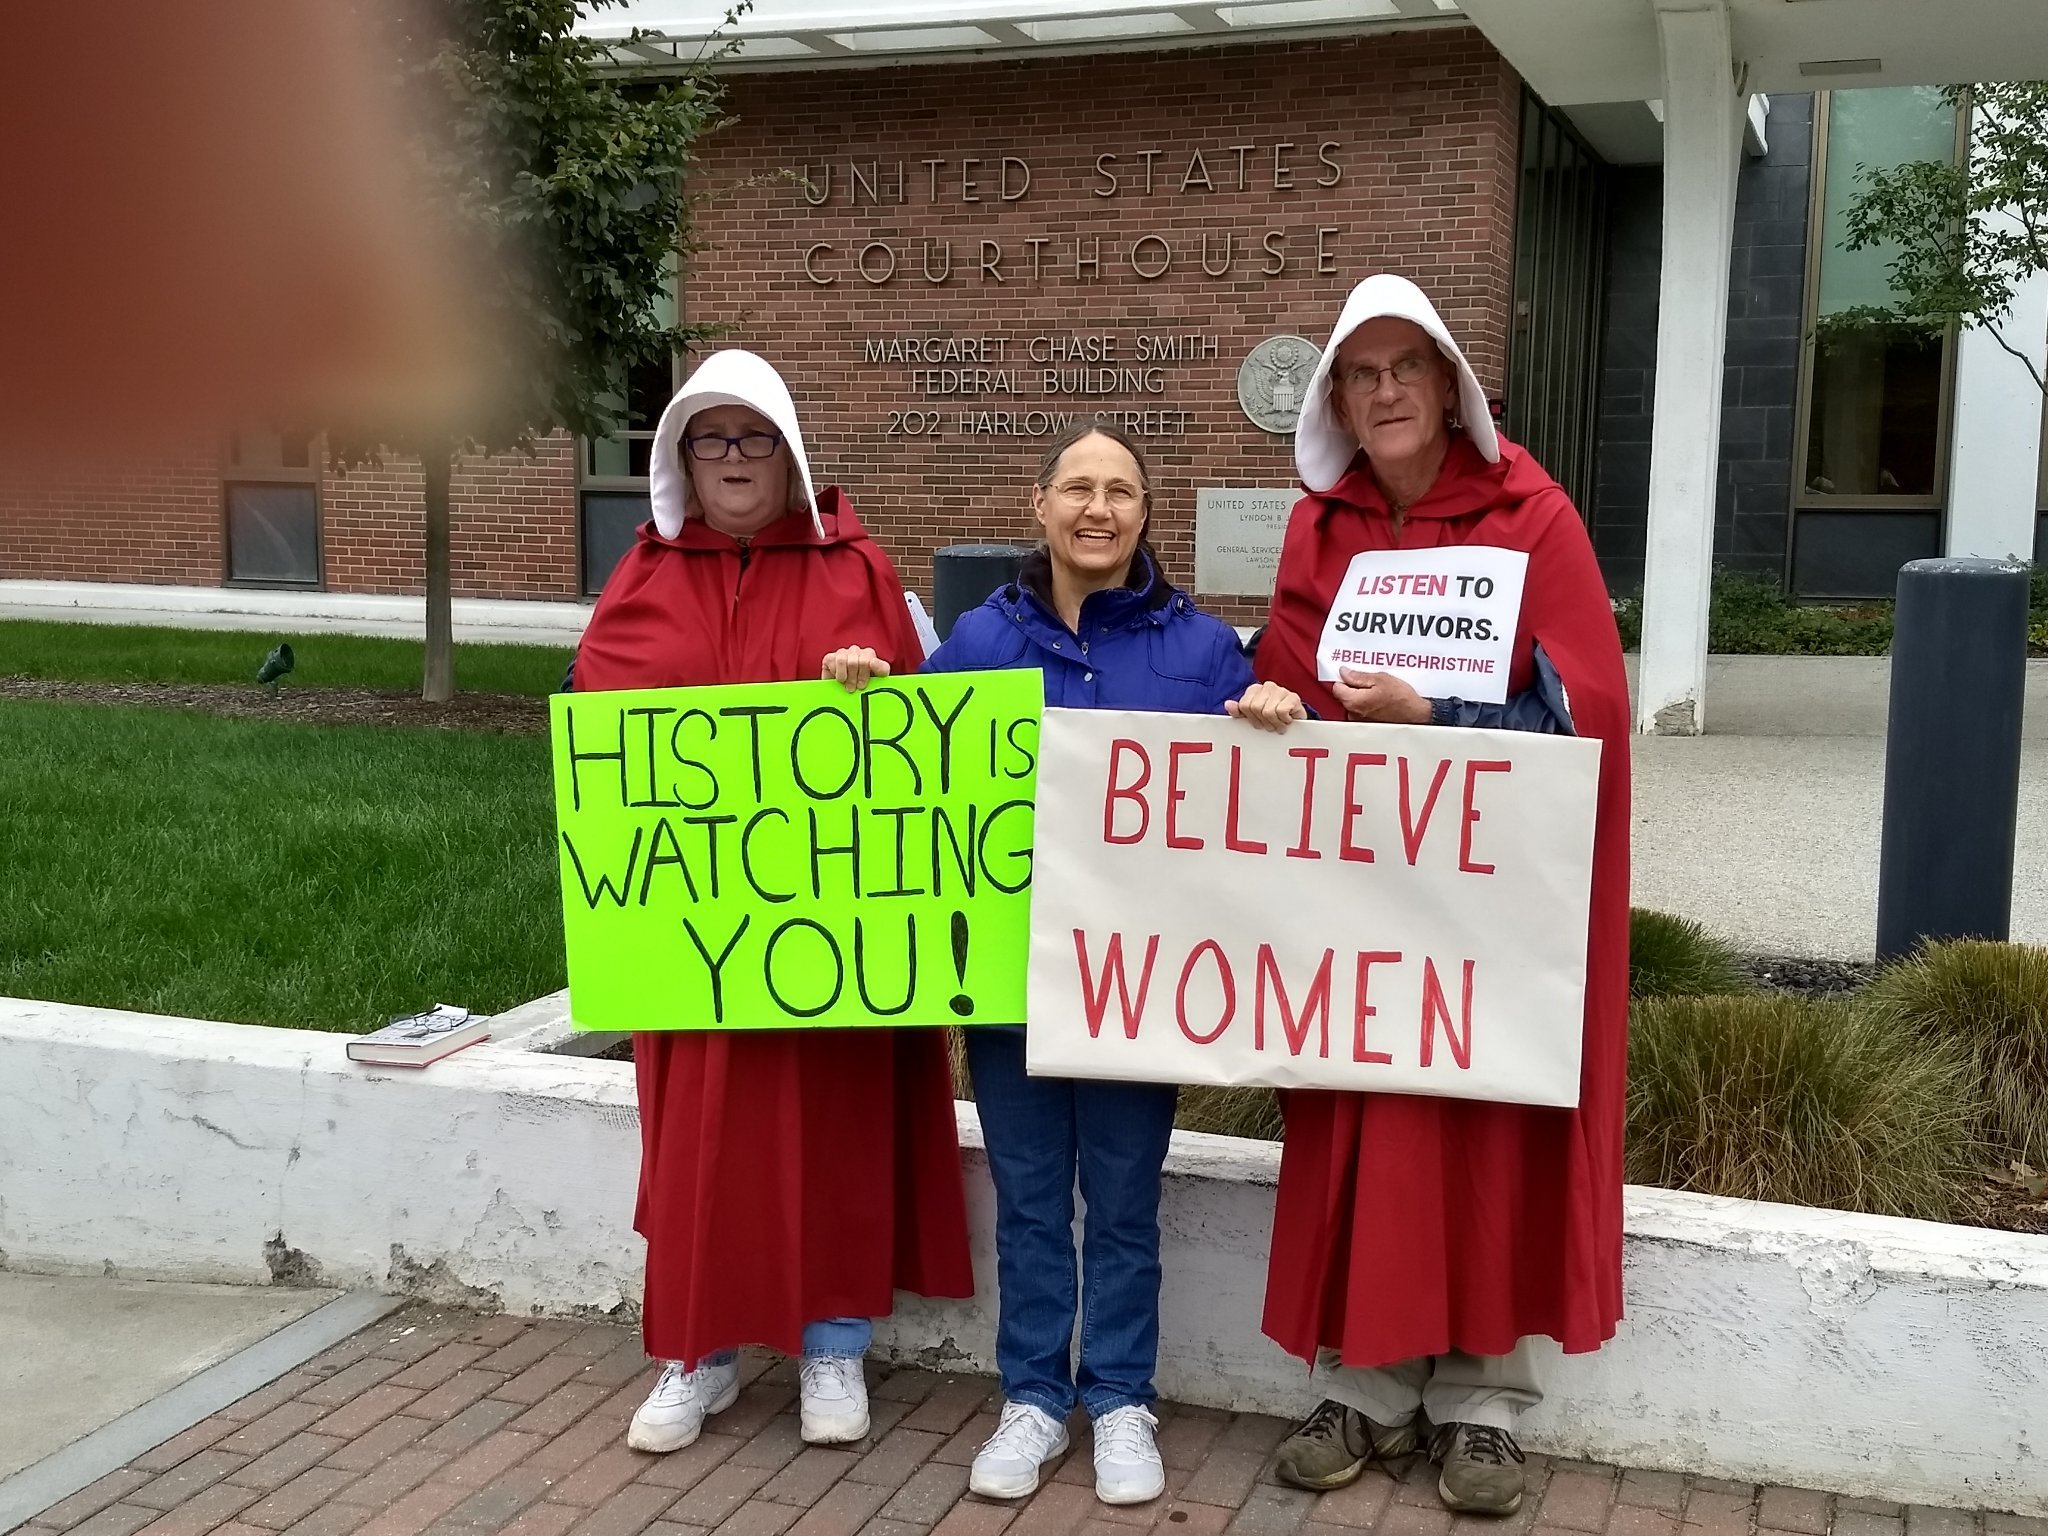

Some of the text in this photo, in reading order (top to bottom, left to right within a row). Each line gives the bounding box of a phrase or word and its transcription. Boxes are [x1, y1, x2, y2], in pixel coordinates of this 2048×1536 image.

[803, 141, 1343, 205] UNITED STATES
[804, 228, 1340, 285] COURTHOUSE
[864, 333, 1219, 363] MARGARET CHASE SMITH
[911, 366, 1165, 395] FEDERAL BUILDING
[886, 410, 942, 436] 202
[958, 410, 1074, 436] HARLOW
[1207, 501, 1286, 510] UNITED STATES
[1240, 514, 1273, 522] LYNDON
[1216, 545, 1249, 554] GENERAL
[1357, 574, 1494, 599] LISTEN TO
[1335, 611, 1500, 642] SURVIVORS.
[1331, 649, 1496, 674] #BELIEVECHRISTINE
[566, 686, 1038, 812] HISTORY IS
[1103, 738, 1512, 875] BELIEVE
[562, 799, 1036, 910] WATCHING
[682, 910, 976, 1024] YOU!
[1073, 928, 1476, 1071] WOMEN
